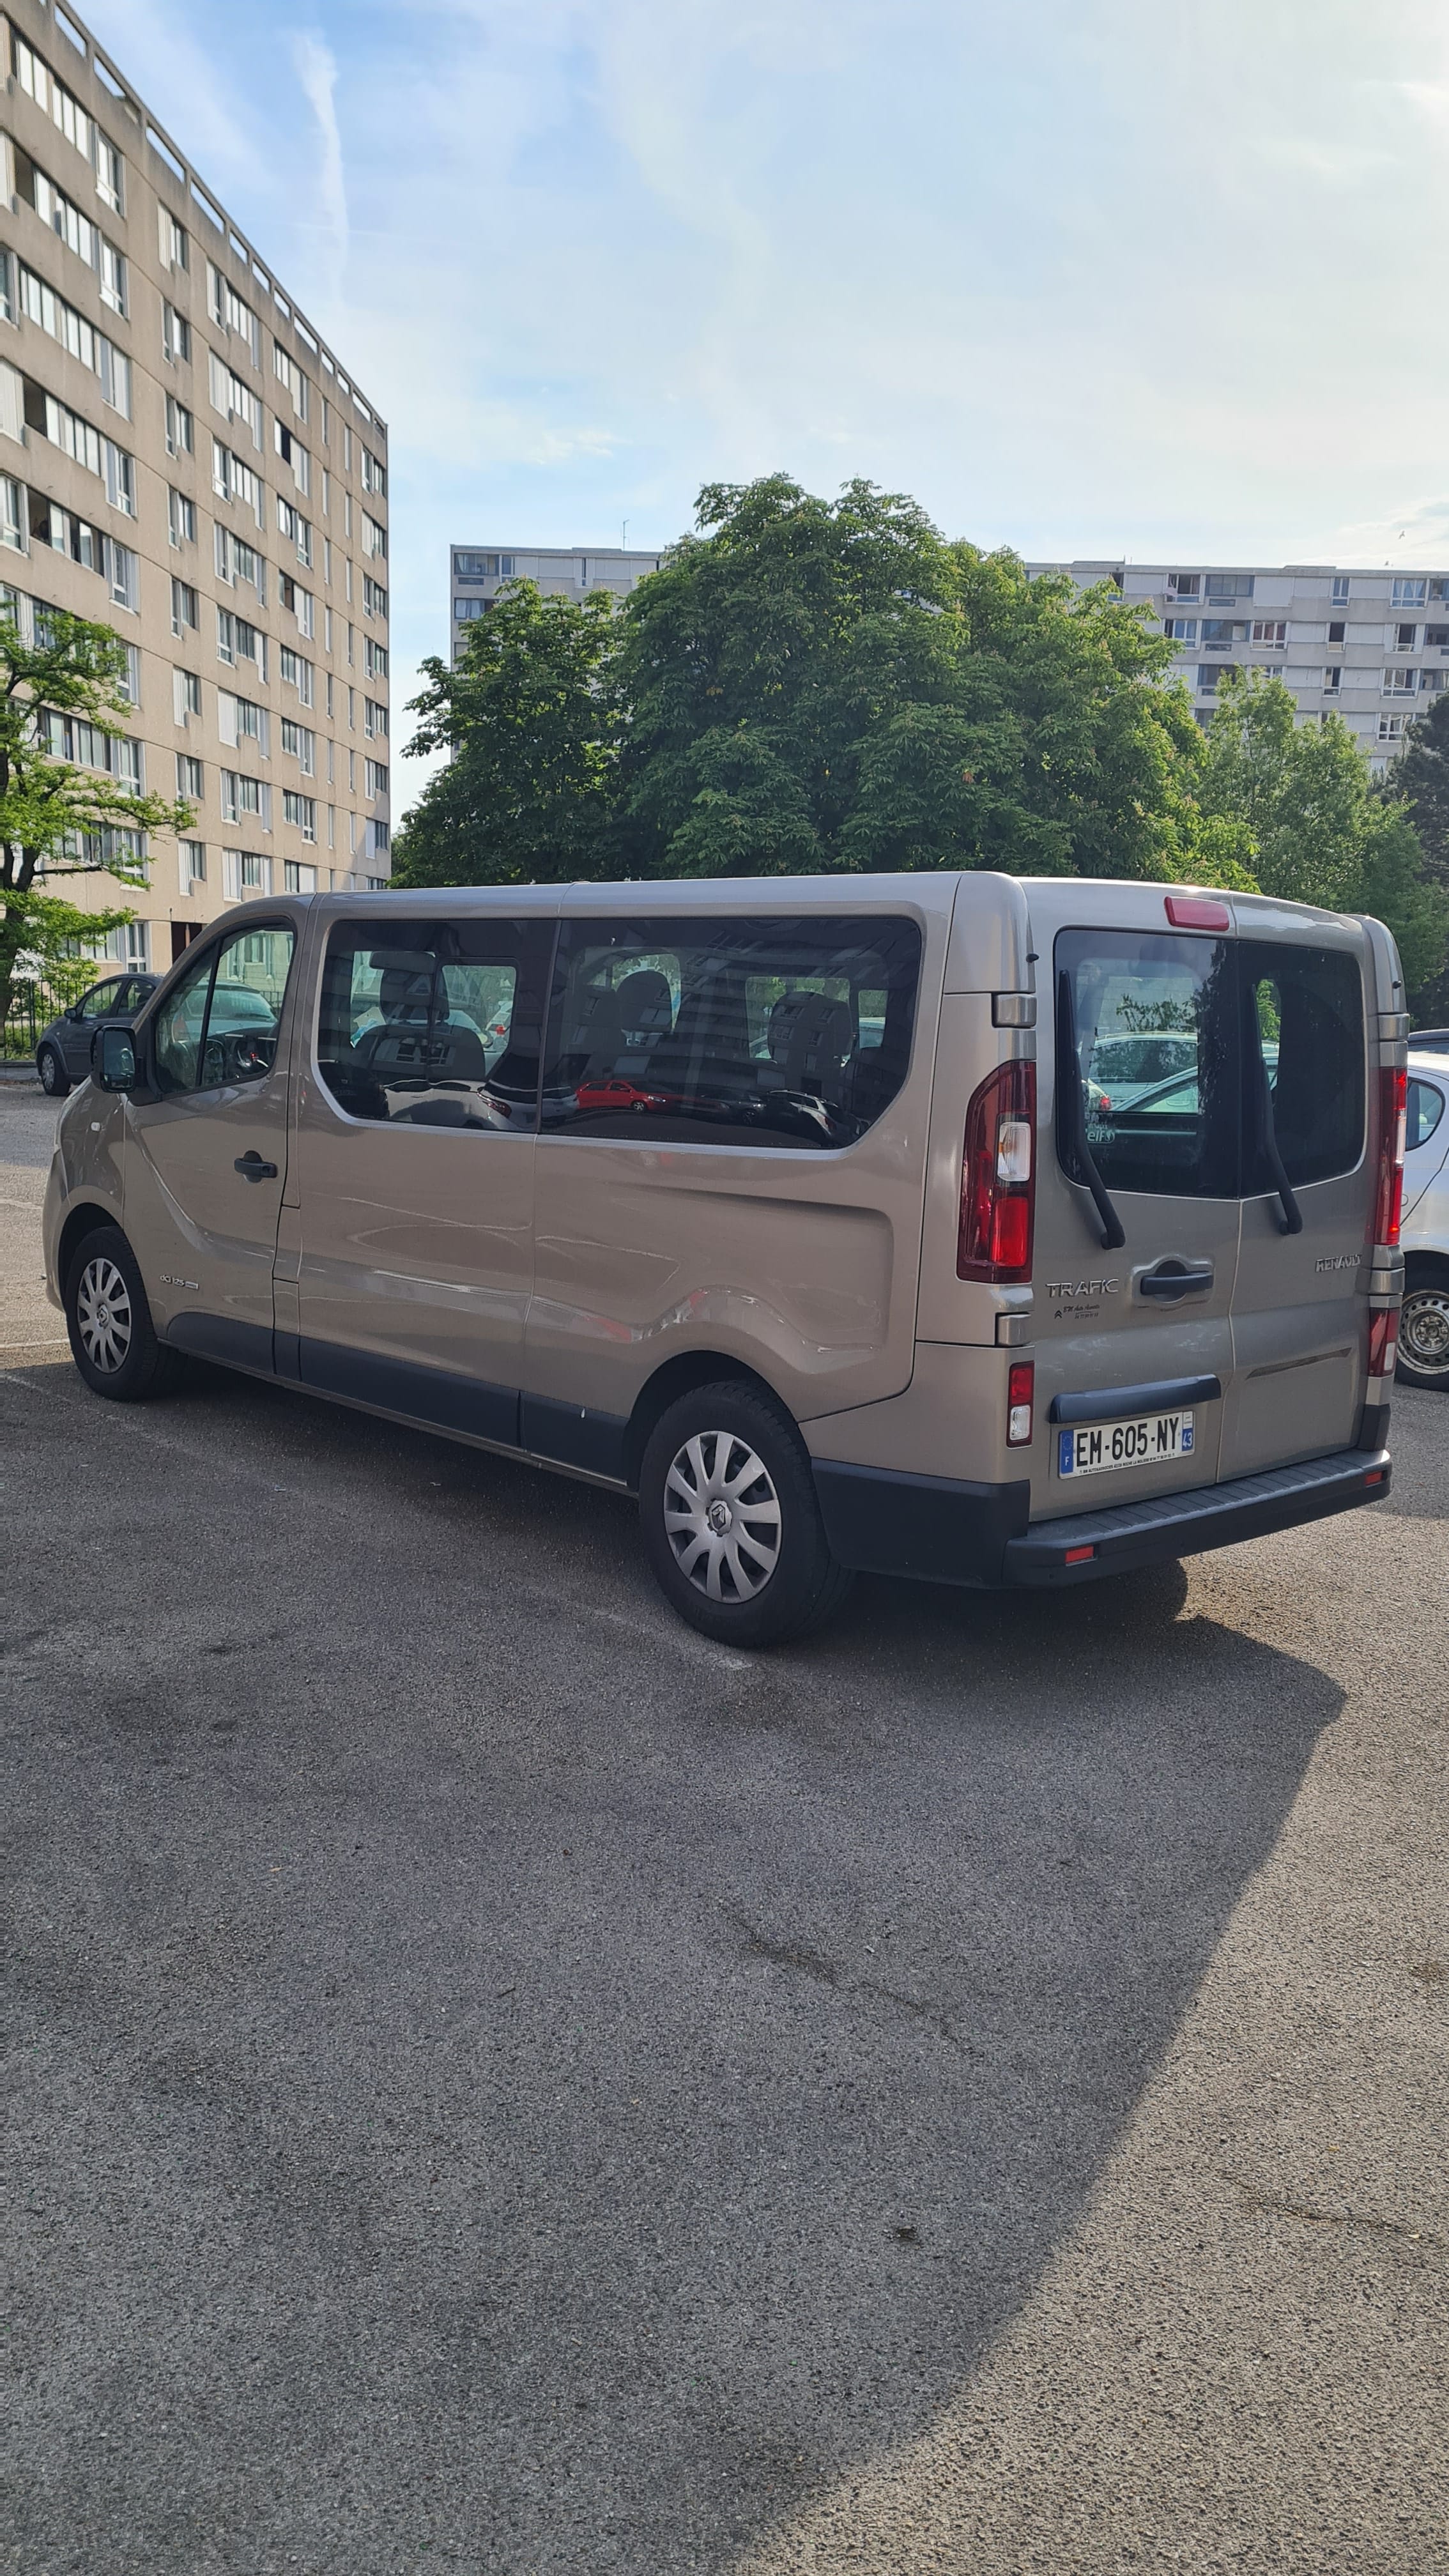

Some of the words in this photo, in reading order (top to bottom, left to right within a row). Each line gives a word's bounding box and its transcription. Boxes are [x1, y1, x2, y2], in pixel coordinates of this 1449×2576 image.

[1087, 1128, 1105, 1142] elf
[1315, 1254, 1361, 1273] RENAULT
[172, 1278, 185, 1286] 125
[1046, 1279, 1119, 1298] TRAFIC
[1077, 1417, 1179, 1468] EM-605-NY
[1183, 1432, 1193, 1448] 43
[1064, 1457, 1070, 1466] F
